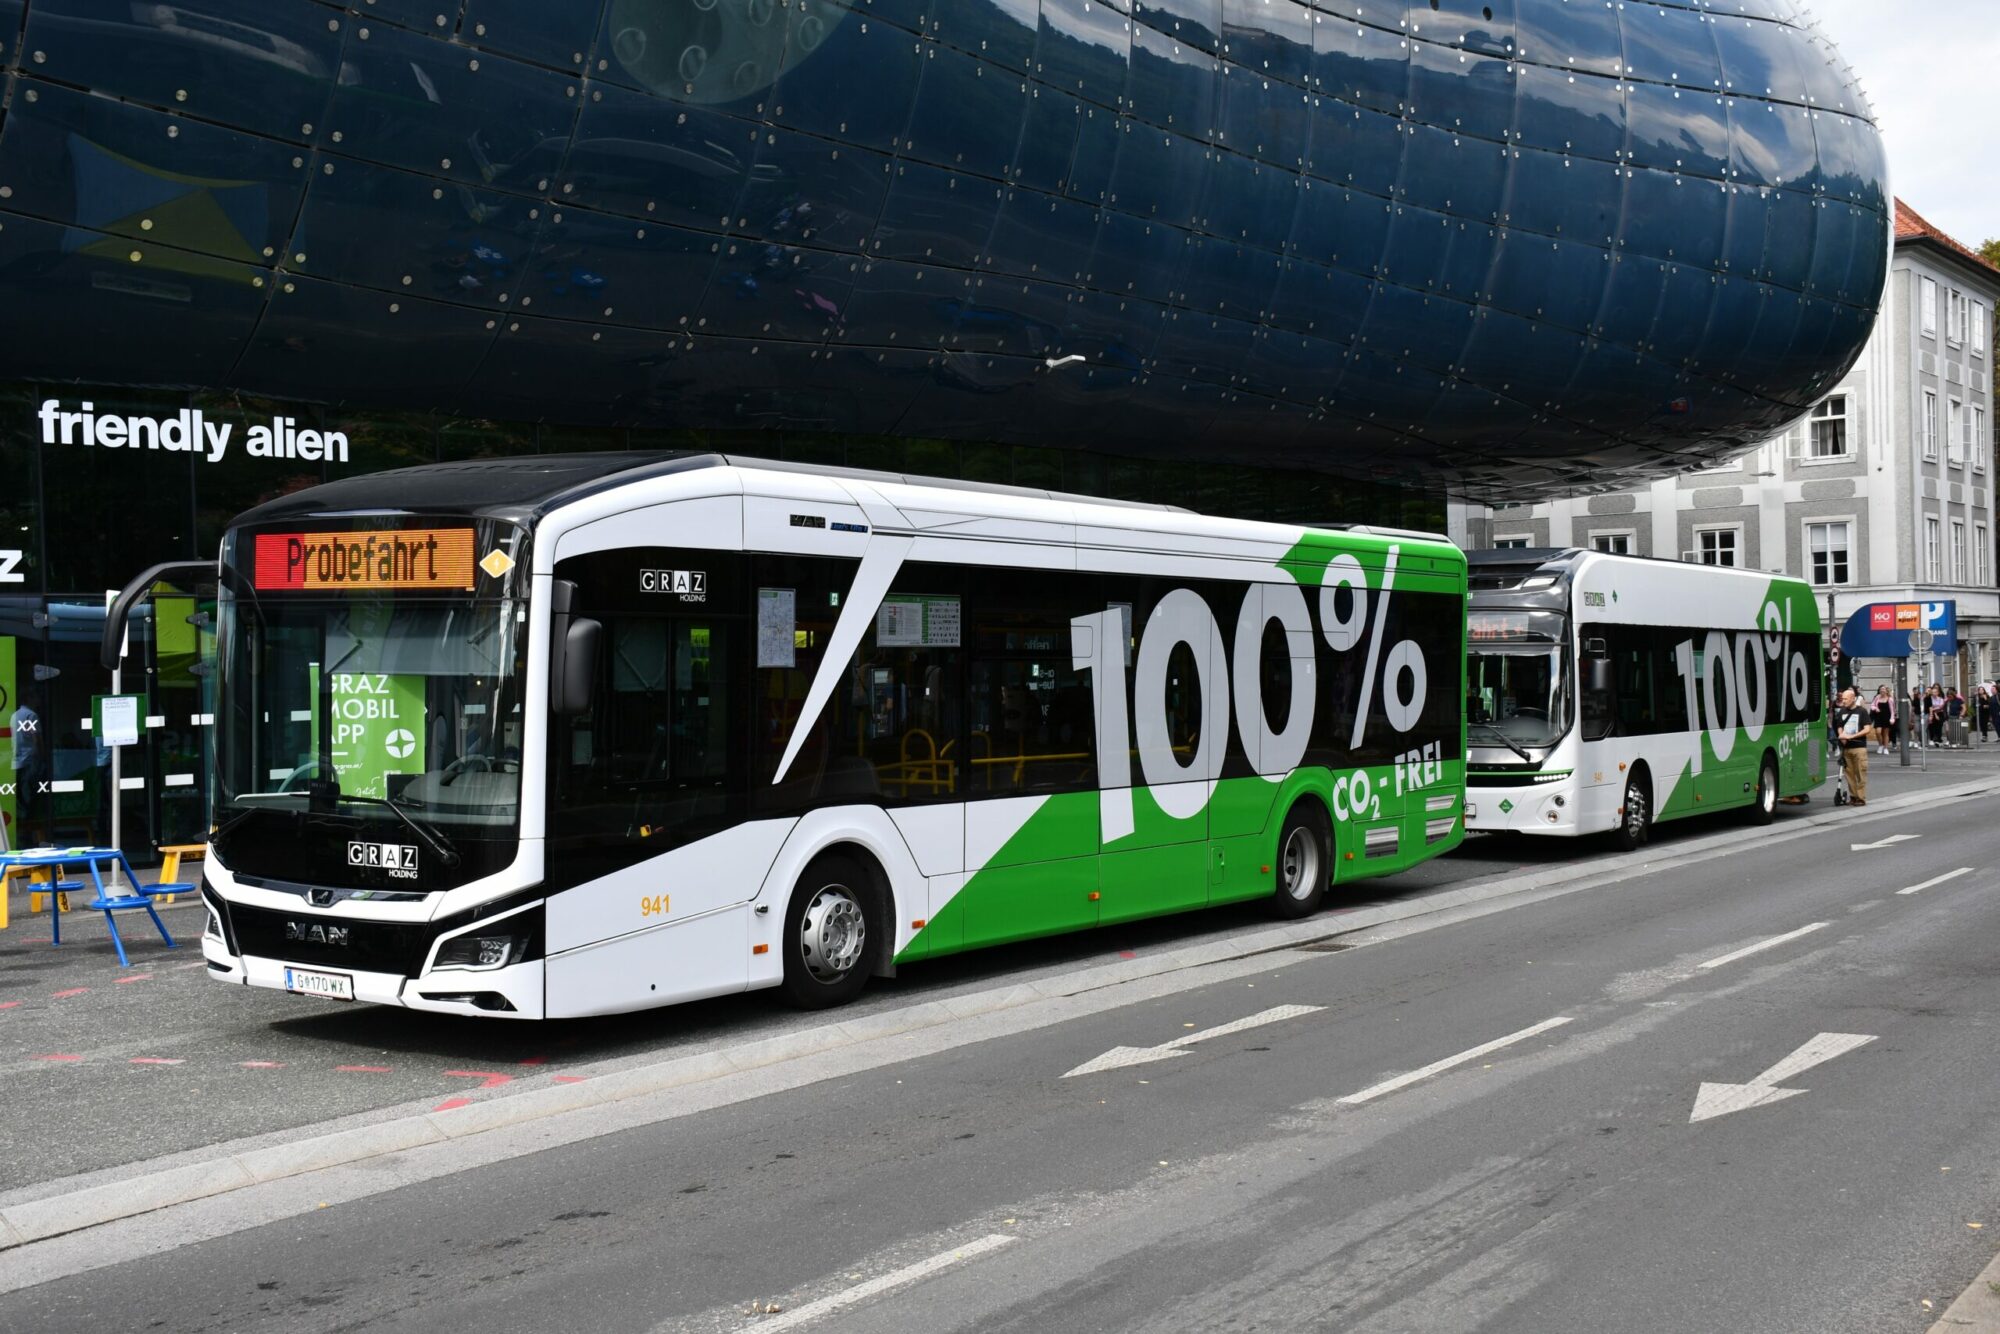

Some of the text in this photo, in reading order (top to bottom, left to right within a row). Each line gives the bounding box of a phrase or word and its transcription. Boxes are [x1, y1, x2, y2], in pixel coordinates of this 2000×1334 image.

[38, 399, 349, 463] friendly alien
[287, 533, 438, 583] Probefahrt
[640, 569, 706, 593] GRAZ
[680, 594, 706, 602] HOLDING
[1897, 610, 1919, 618] giga
[1920, 603, 1945, 629] P
[1071, 544, 1427, 844] 100%
[1675, 597, 1808, 778] 100%
[348, 841, 418, 870] GRAZ
[388, 869, 418, 879] HOLDING
[641, 894, 670, 917] 941
[287, 921, 349, 945] MAN
